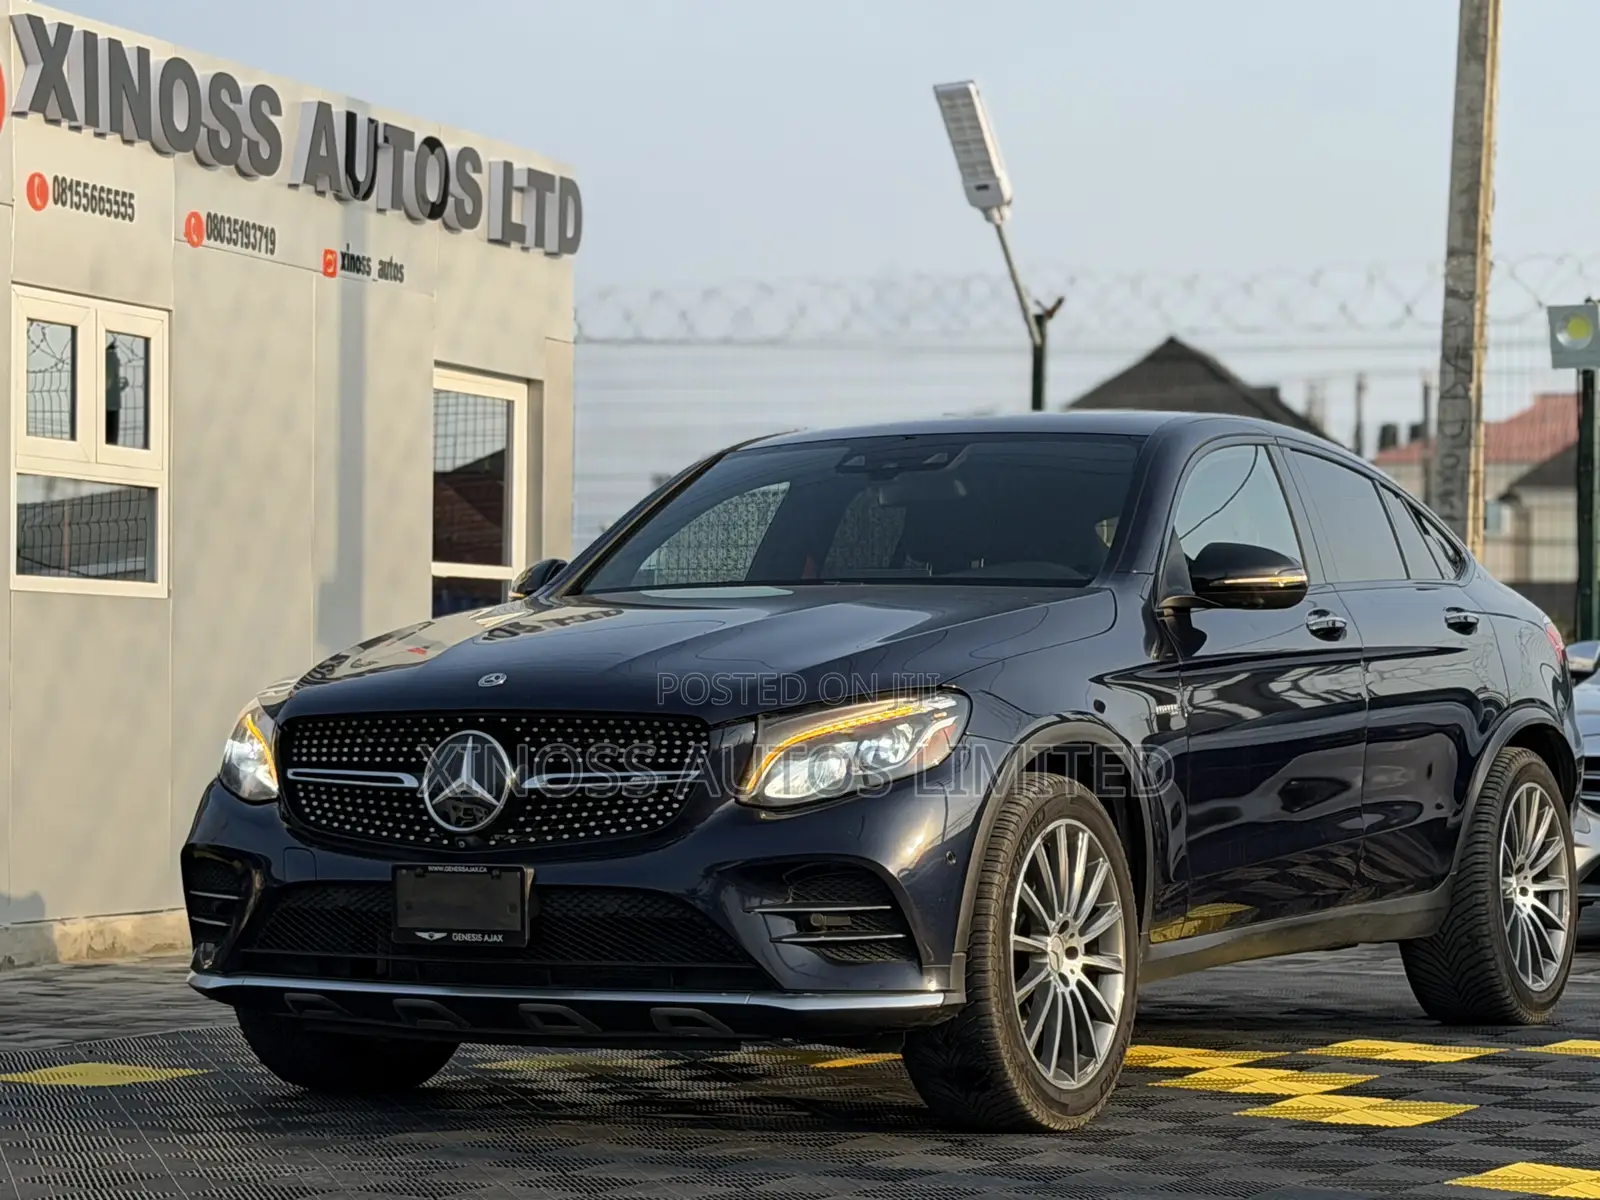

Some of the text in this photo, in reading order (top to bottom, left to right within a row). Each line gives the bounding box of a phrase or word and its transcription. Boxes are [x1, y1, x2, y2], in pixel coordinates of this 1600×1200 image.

[11, 14, 583, 256] XINOSS AUTOS LTD
[52, 174, 136, 223] 08155665555
[205, 211, 276, 256] 08035193719
[451, 932, 504, 943] GENESIS AJAX
